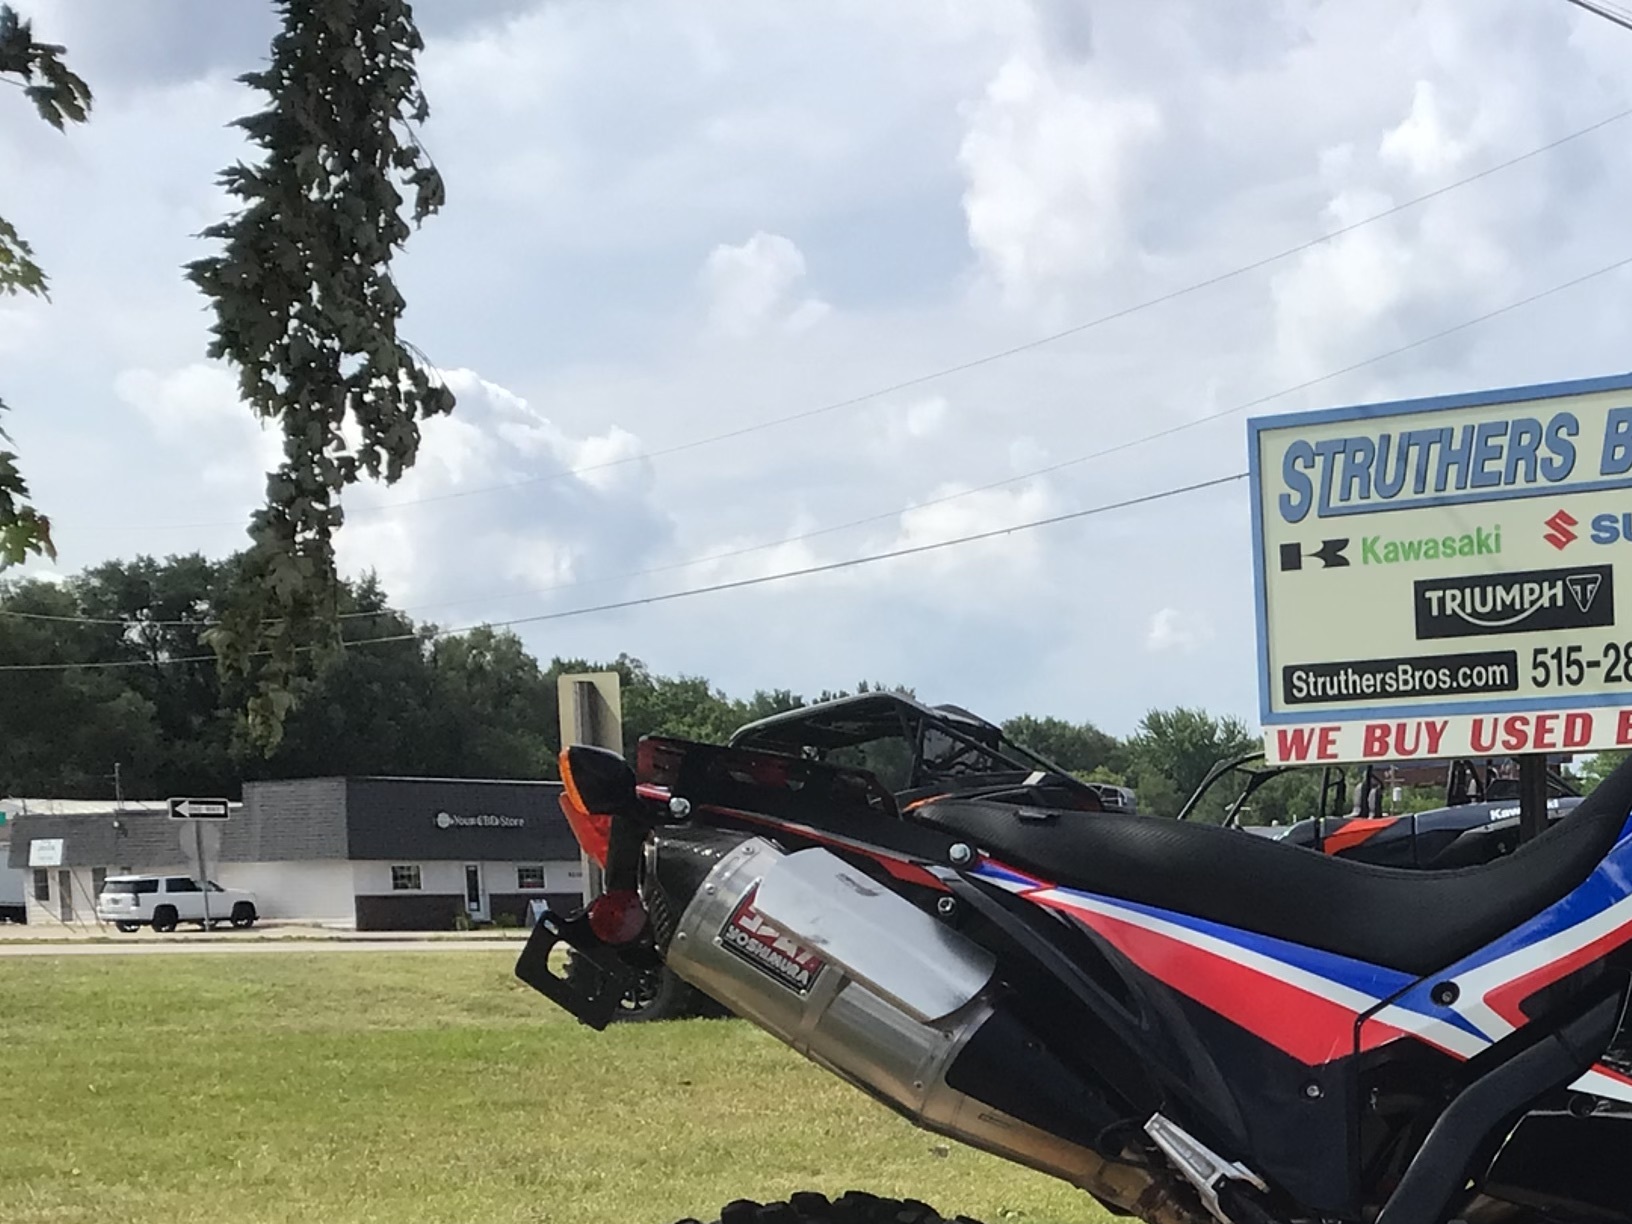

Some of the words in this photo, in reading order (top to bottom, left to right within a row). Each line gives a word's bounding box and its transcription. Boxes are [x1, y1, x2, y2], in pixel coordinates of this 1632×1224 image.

[1278, 411, 1580, 523] STRUTHERS
[1361, 524, 1502, 566] Kawasaki
[1425, 579, 1565, 624] TRIUMPH
[1291, 663, 1510, 700] StruthersBros.com
[1277, 726, 1342, 763] WE
[1363, 721, 1449, 758] BUY
[1470, 712, 1594, 753] USED
[500, 815, 525, 827] Store
[725, 925, 810, 986] YOSHIMURA
